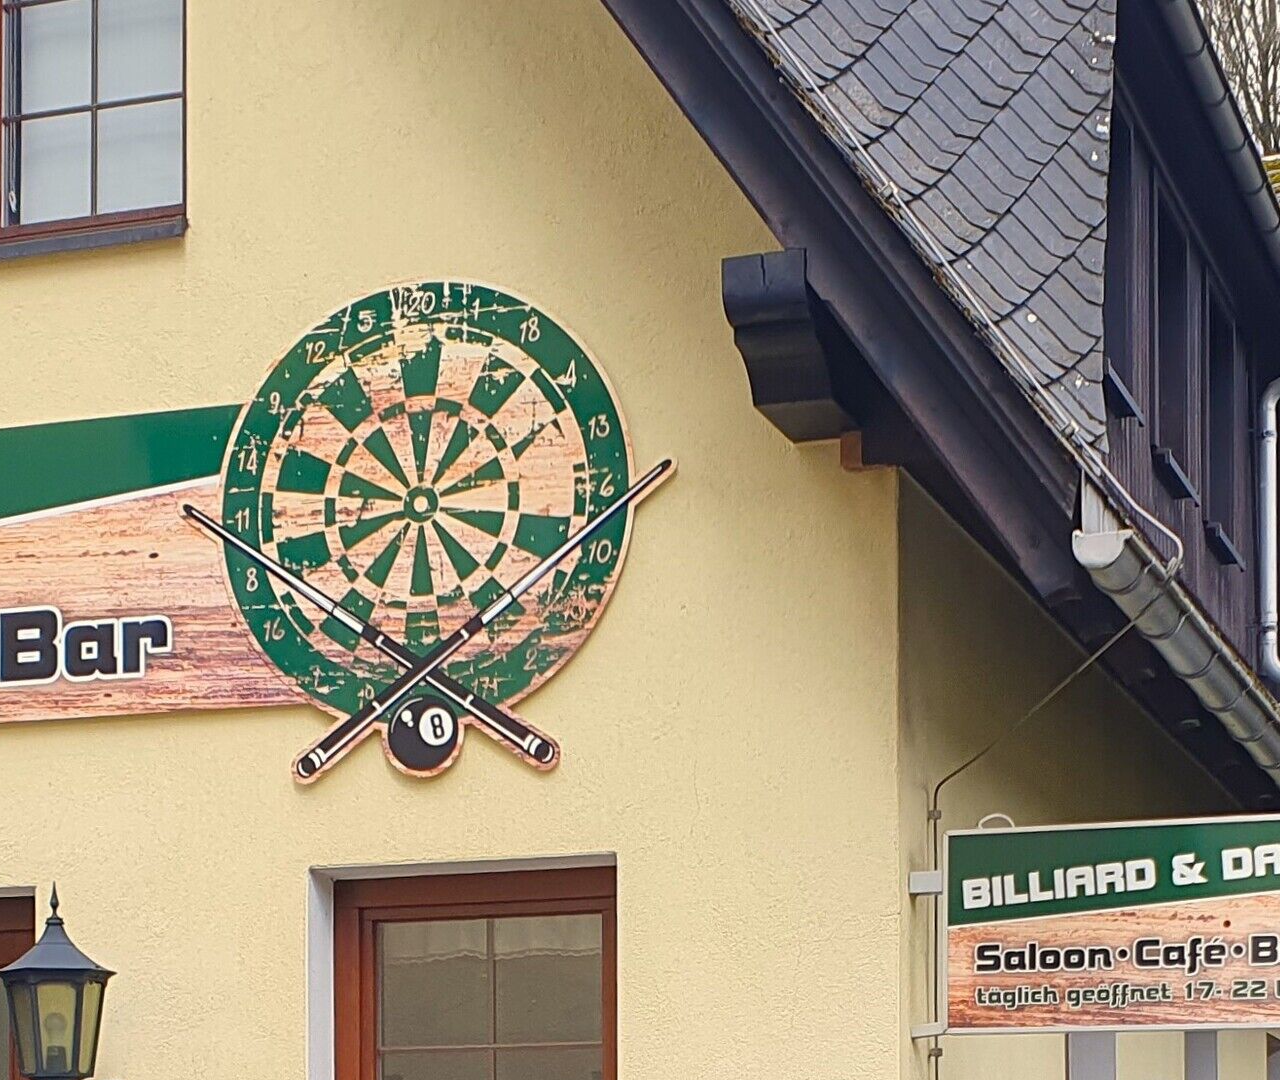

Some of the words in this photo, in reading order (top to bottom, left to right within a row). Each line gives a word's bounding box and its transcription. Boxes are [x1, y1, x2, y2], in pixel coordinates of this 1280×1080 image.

[520, 316, 540, 343] 18
[306, 341, 326, 364] 12
[588, 414, 610, 440] 13
[589, 539, 613, 564] 10
[246, 567, 258, 592] 8
[264, 617, 284, 642] 16
[523, 648, 537, 671] 2
[430, 714, 445, 739] 8
[962, 858, 1156, 910] BILLIARD
[1171, 853, 1208, 886] &
[975, 985, 1058, 1009] täglich
[1067, 982, 1171, 1008] geöffnet
[1232, 979, 1266, 998] 22
